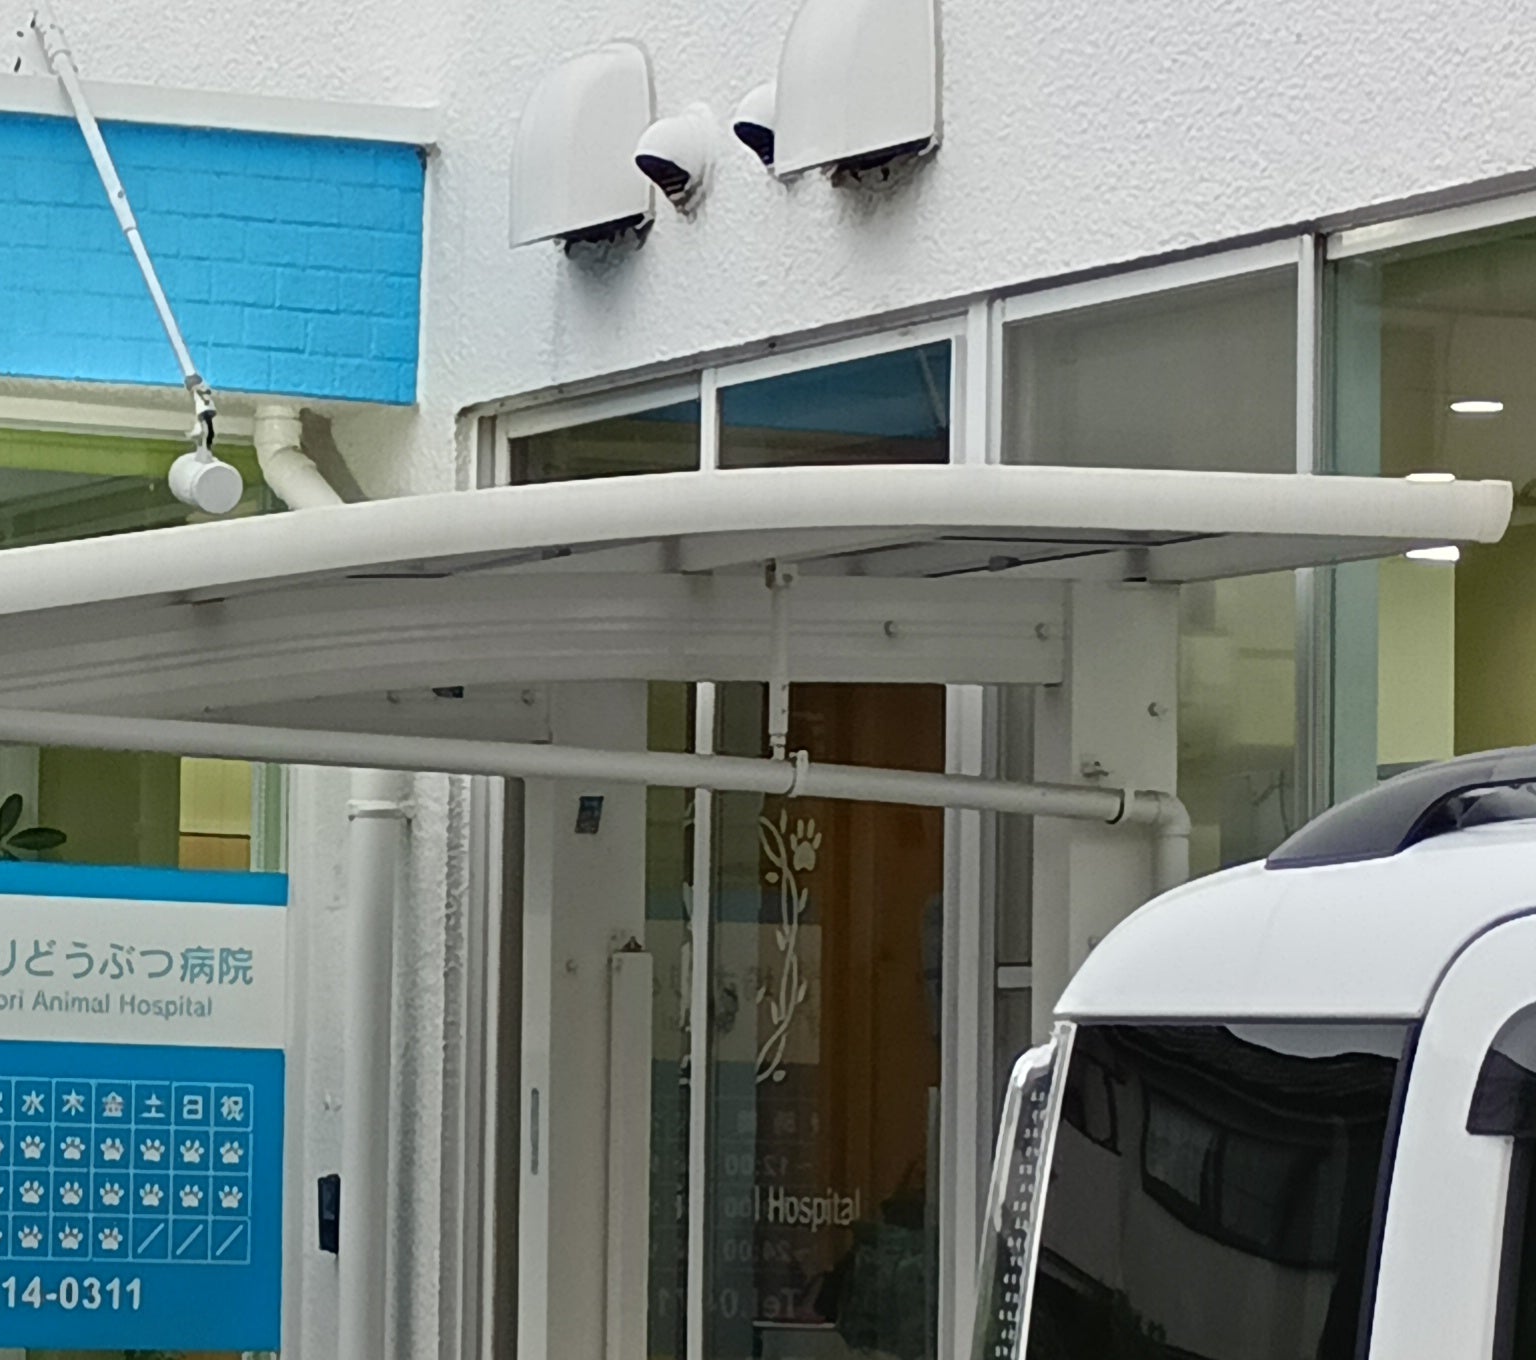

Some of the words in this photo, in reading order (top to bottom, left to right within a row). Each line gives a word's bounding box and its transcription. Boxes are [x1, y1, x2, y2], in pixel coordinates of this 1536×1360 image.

[31, 990, 111, 1014] Animal
[119, 994, 213, 1020] Hospital
[21, 1090, 45, 1116] 水
[61, 1089, 85, 1116] 木
[102, 1091, 124, 1118] 金
[139, 1094, 165, 1119] 土
[182, 1094, 204, 1120] 日
[220, 1095, 244, 1121] 祝
[767, 1185, 860, 1233] Hospital
